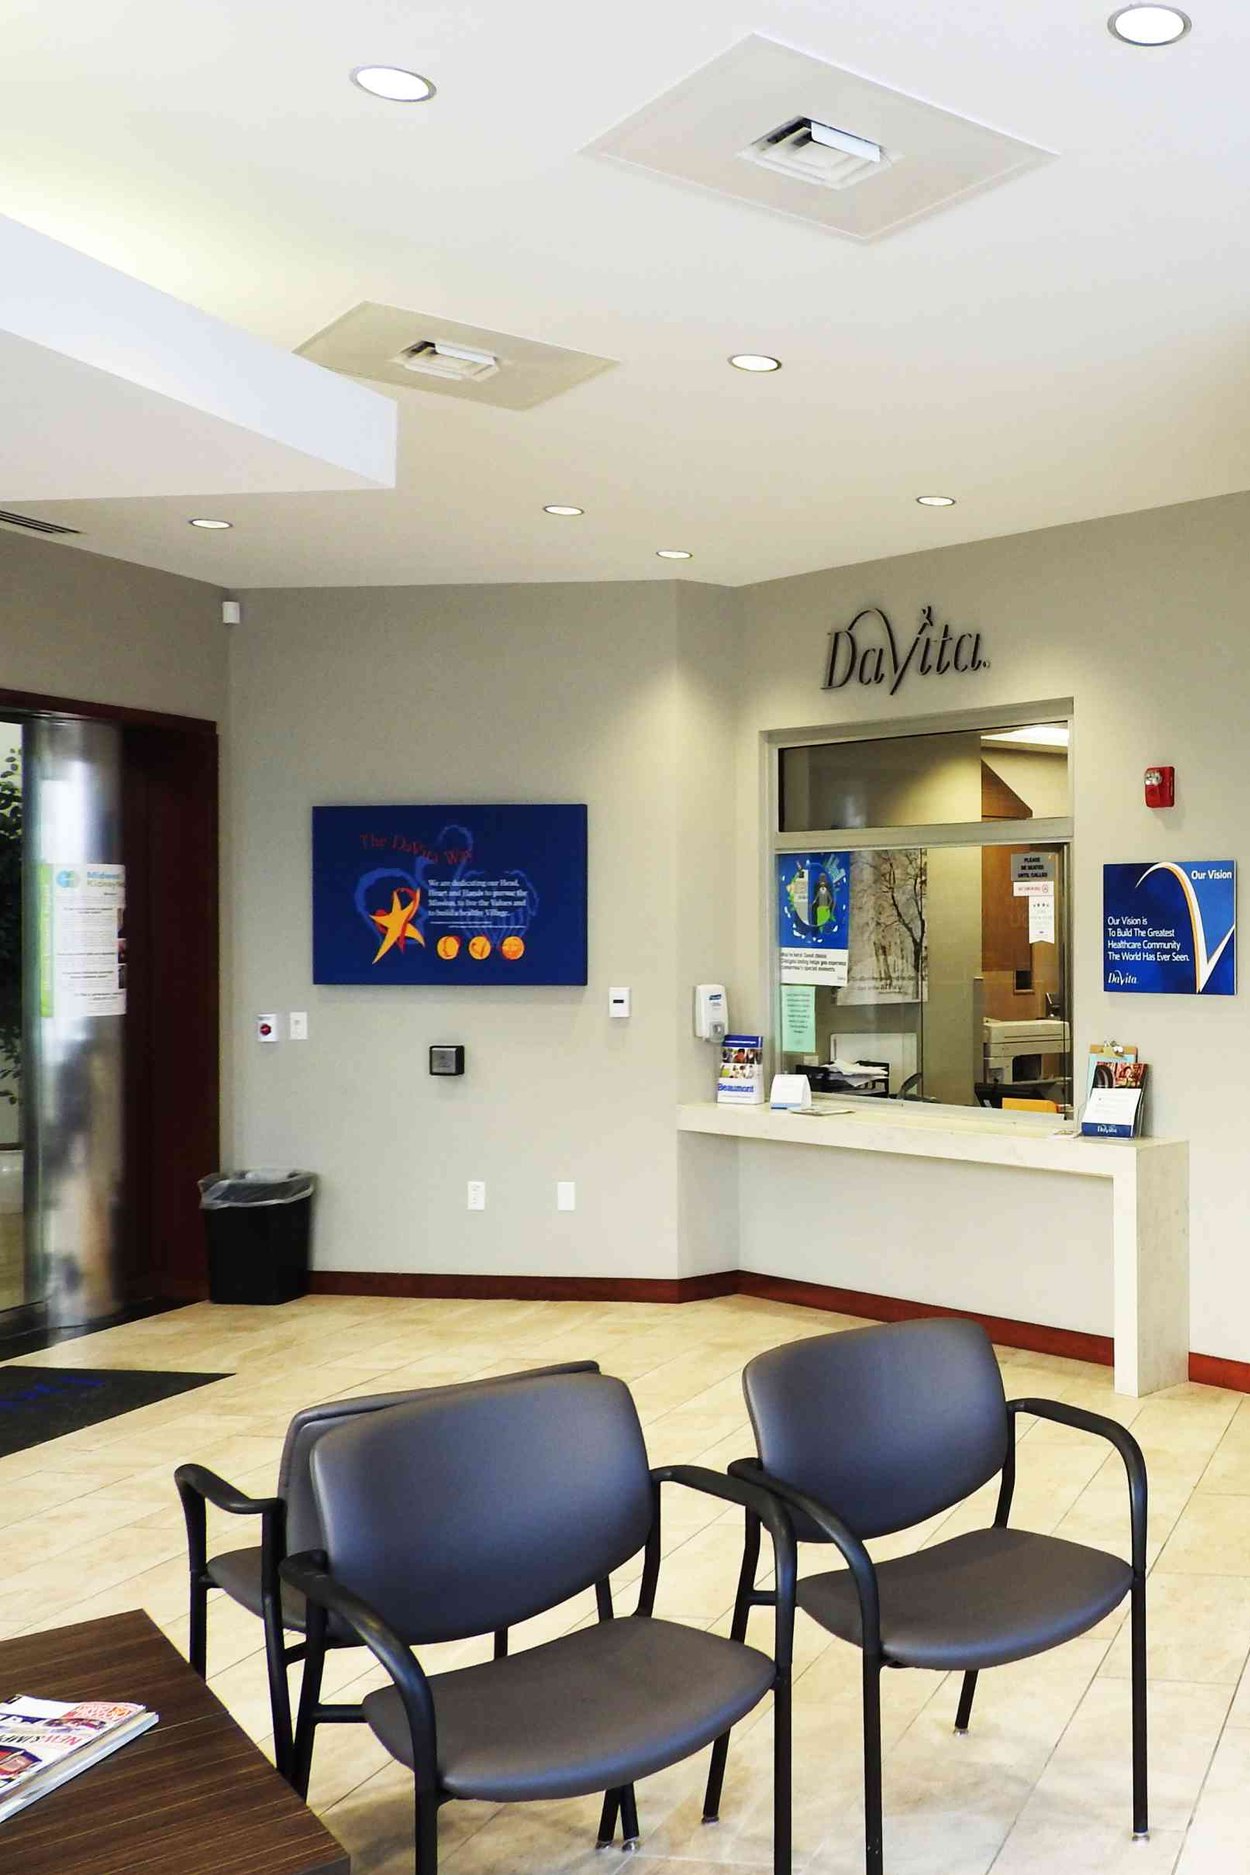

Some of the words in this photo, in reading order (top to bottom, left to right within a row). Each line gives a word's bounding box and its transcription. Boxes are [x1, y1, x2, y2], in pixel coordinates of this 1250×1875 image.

[1191, 870, 1206, 880] Our
[1207, 869, 1232, 880] Vision
[1107, 916, 1120, 926] Our
[1121, 916, 1141, 926] Vision
[1142, 915, 1148, 925] is
[1107, 927, 1116, 937] To
[1116, 927, 1133, 937] Build
[1133, 927, 1147, 937] The
[1147, 927, 1175, 937] Greatest
[1107, 939, 1142, 949] Healthcare
[1142, 939, 1181, 951] Community
[1107, 951, 1121, 961] The
[1121, 951, 1142, 961] World
[1142, 951, 1156, 961] Has
[1156, 952, 1171, 962] Ever
[1171, 952, 1190, 962] Seen.
[1108, 969, 1137, 986] DaVita
[717, 1083, 755, 1093] Beaumont
